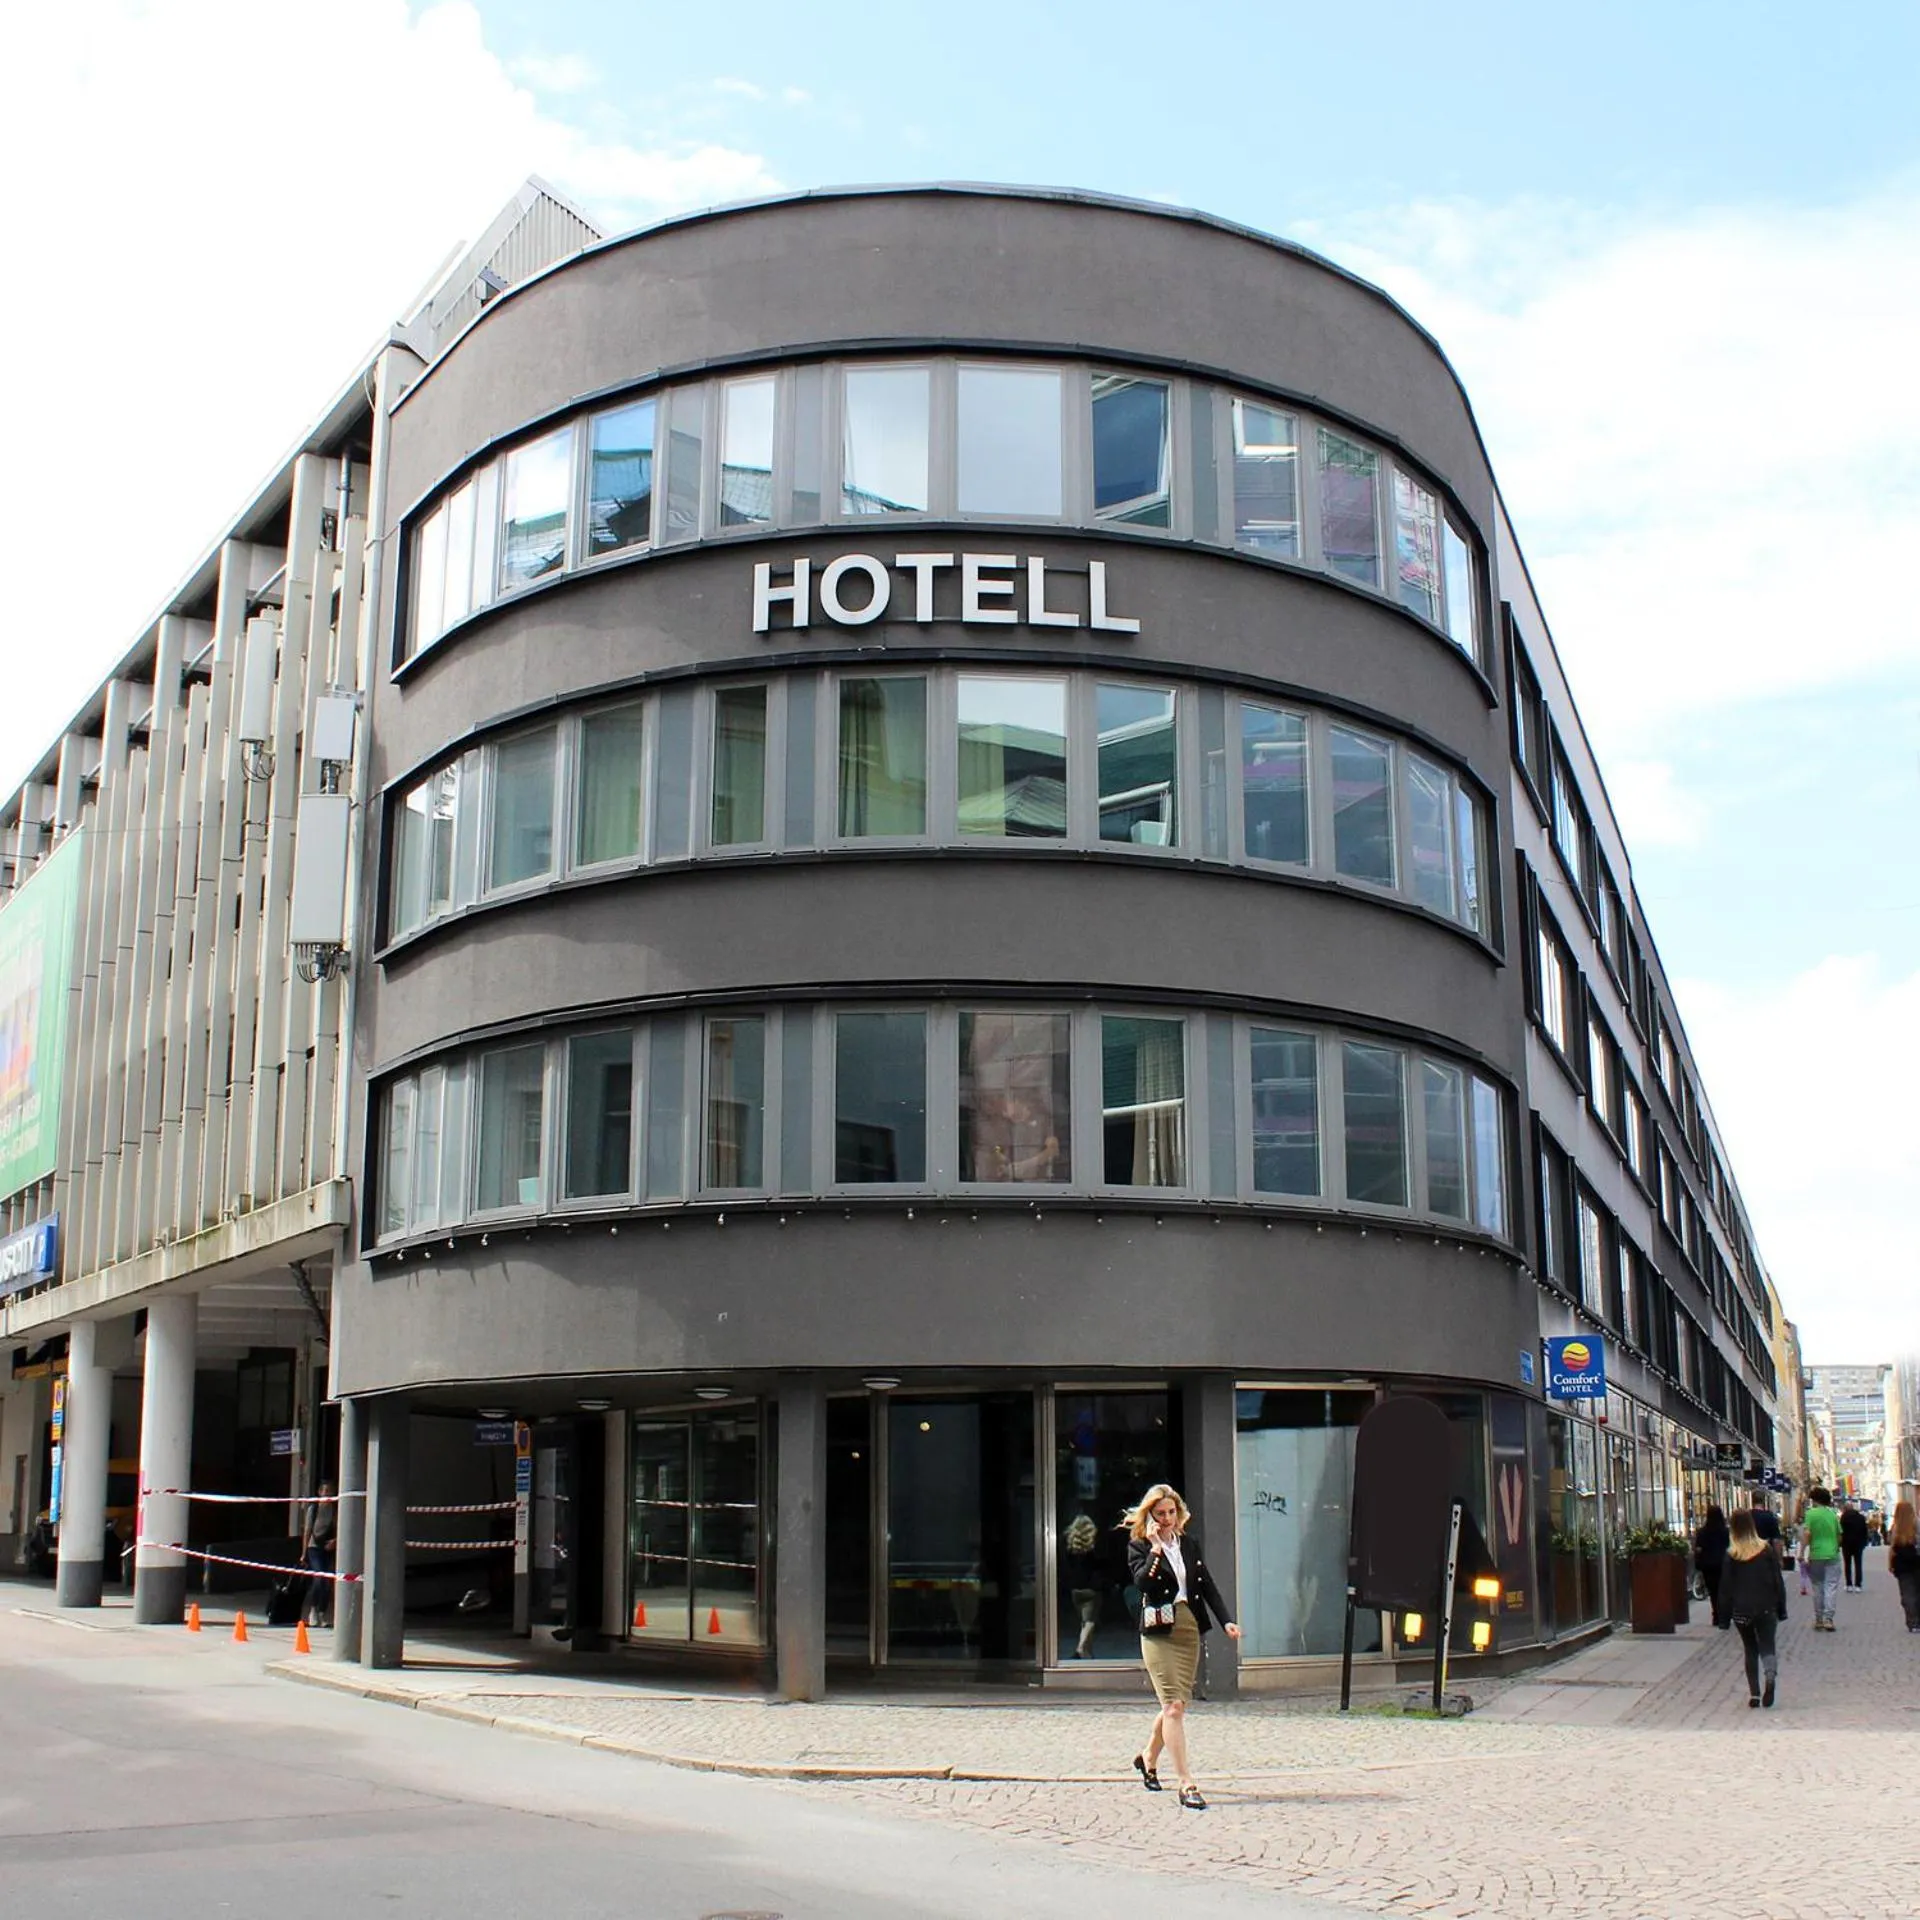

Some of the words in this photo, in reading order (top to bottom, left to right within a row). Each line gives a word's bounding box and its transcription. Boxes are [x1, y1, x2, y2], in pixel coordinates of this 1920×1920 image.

[752, 552, 1141, 634] HOTELL
[1553, 1372, 1600, 1385] Comfort
[1561, 1385, 1594, 1393] HOTEL
